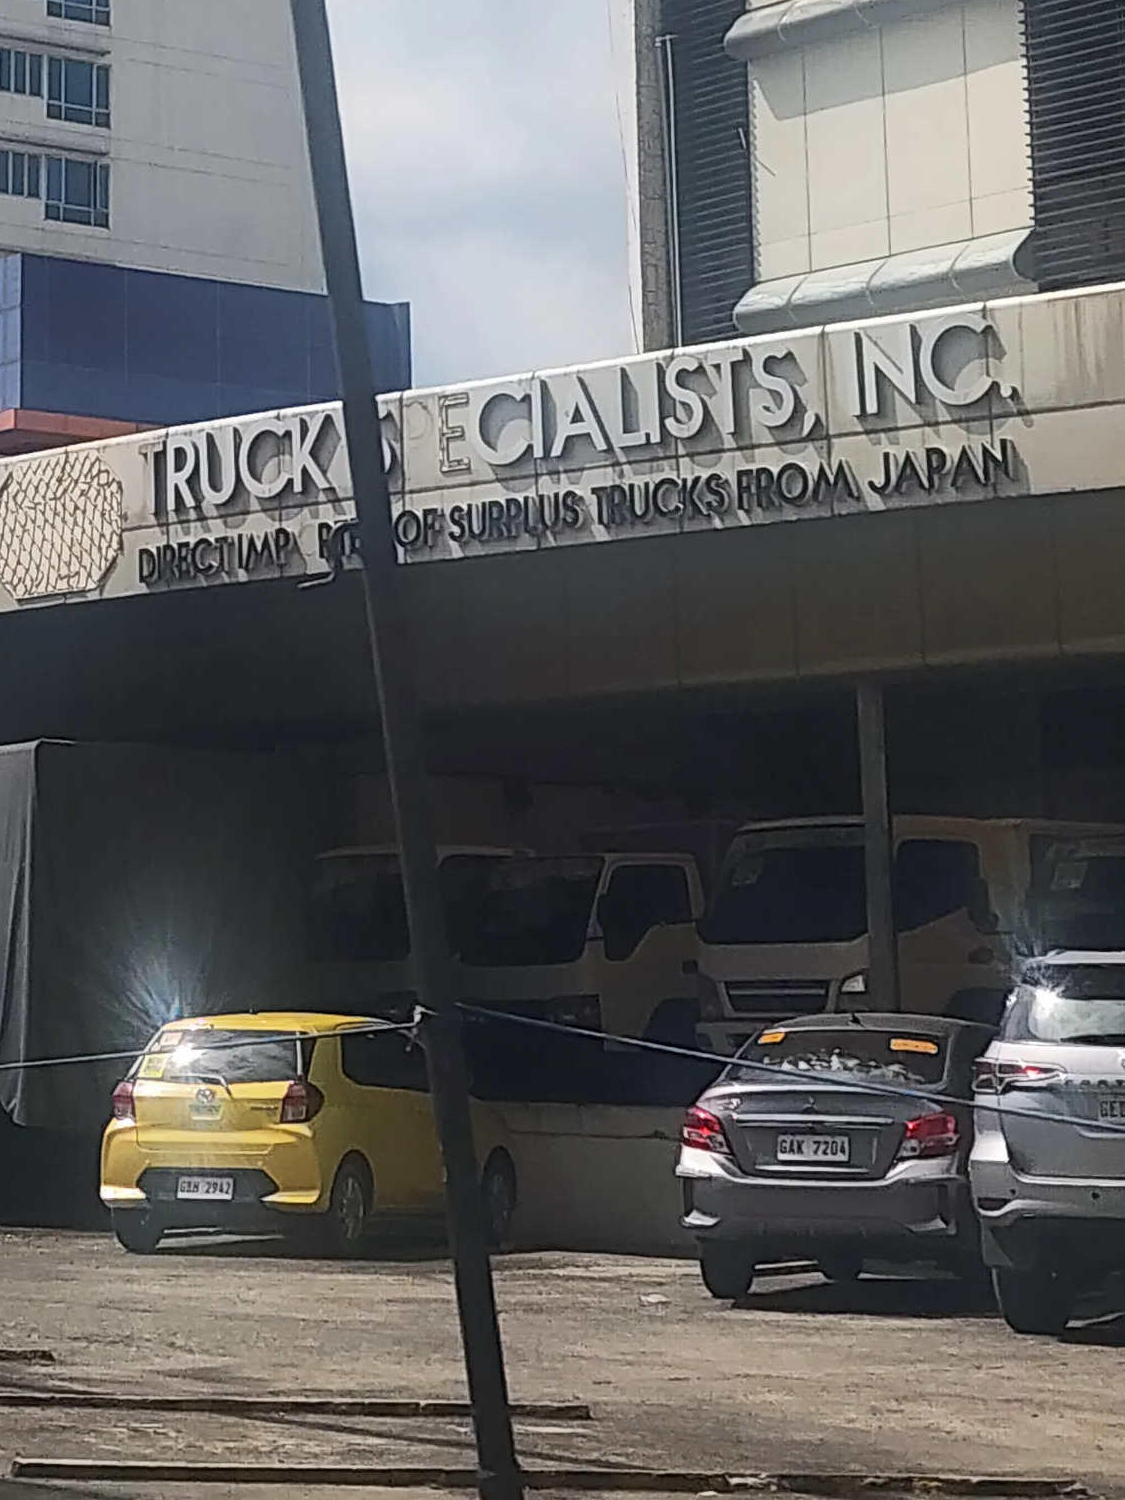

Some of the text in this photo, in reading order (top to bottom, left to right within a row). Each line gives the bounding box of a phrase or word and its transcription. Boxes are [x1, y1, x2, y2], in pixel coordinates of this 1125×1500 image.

[139, 412, 332, 514] TRUCK
[138, 536, 233, 584] DIRECT
[394, 507, 443, 548] OF
[448, 488, 587, 542] SURPLUS
[591, 474, 728, 526] TRUCKS
[737, 459, 859, 510] FROM
[868, 437, 1013, 494] JAPAN
[780, 1139, 847, 1156] GAK 7204
[204, 1181, 231, 1195] 2942
